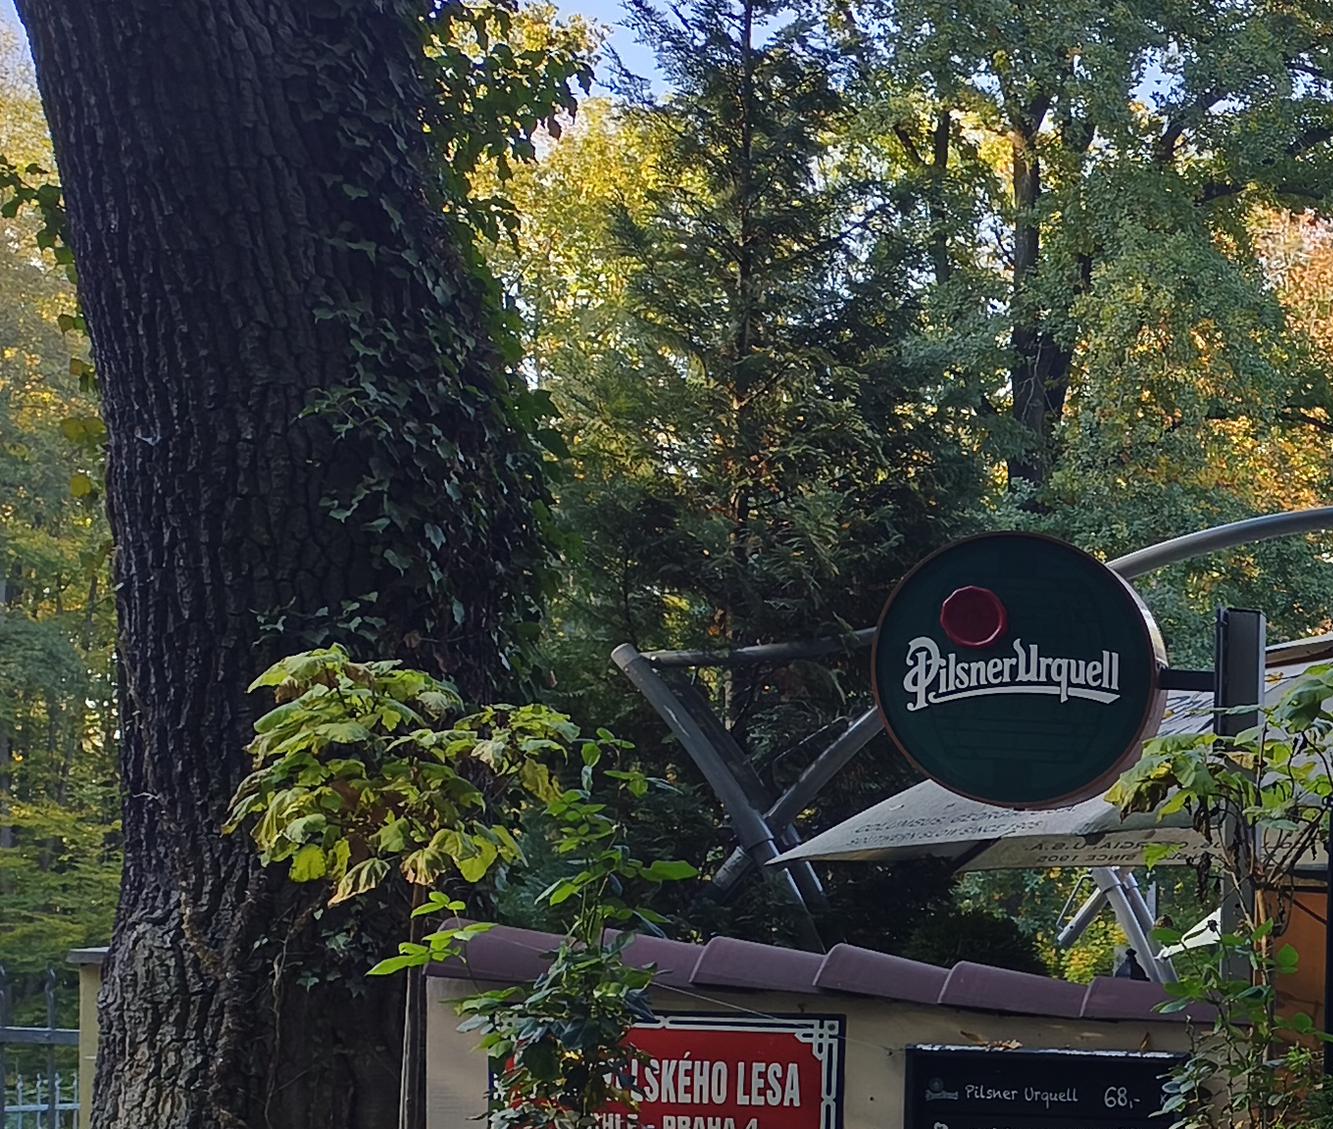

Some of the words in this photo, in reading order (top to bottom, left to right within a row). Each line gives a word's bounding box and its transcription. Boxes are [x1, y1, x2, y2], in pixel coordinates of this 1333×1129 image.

[903, 636, 1020, 711] Pilsner
[1013, 638, 1120, 703] Urquell
[737, 1060, 801, 1108] LESA
[965, 1083, 1018, 1101] Pilsner
[1023, 1086, 1079, 1109] Urquell
